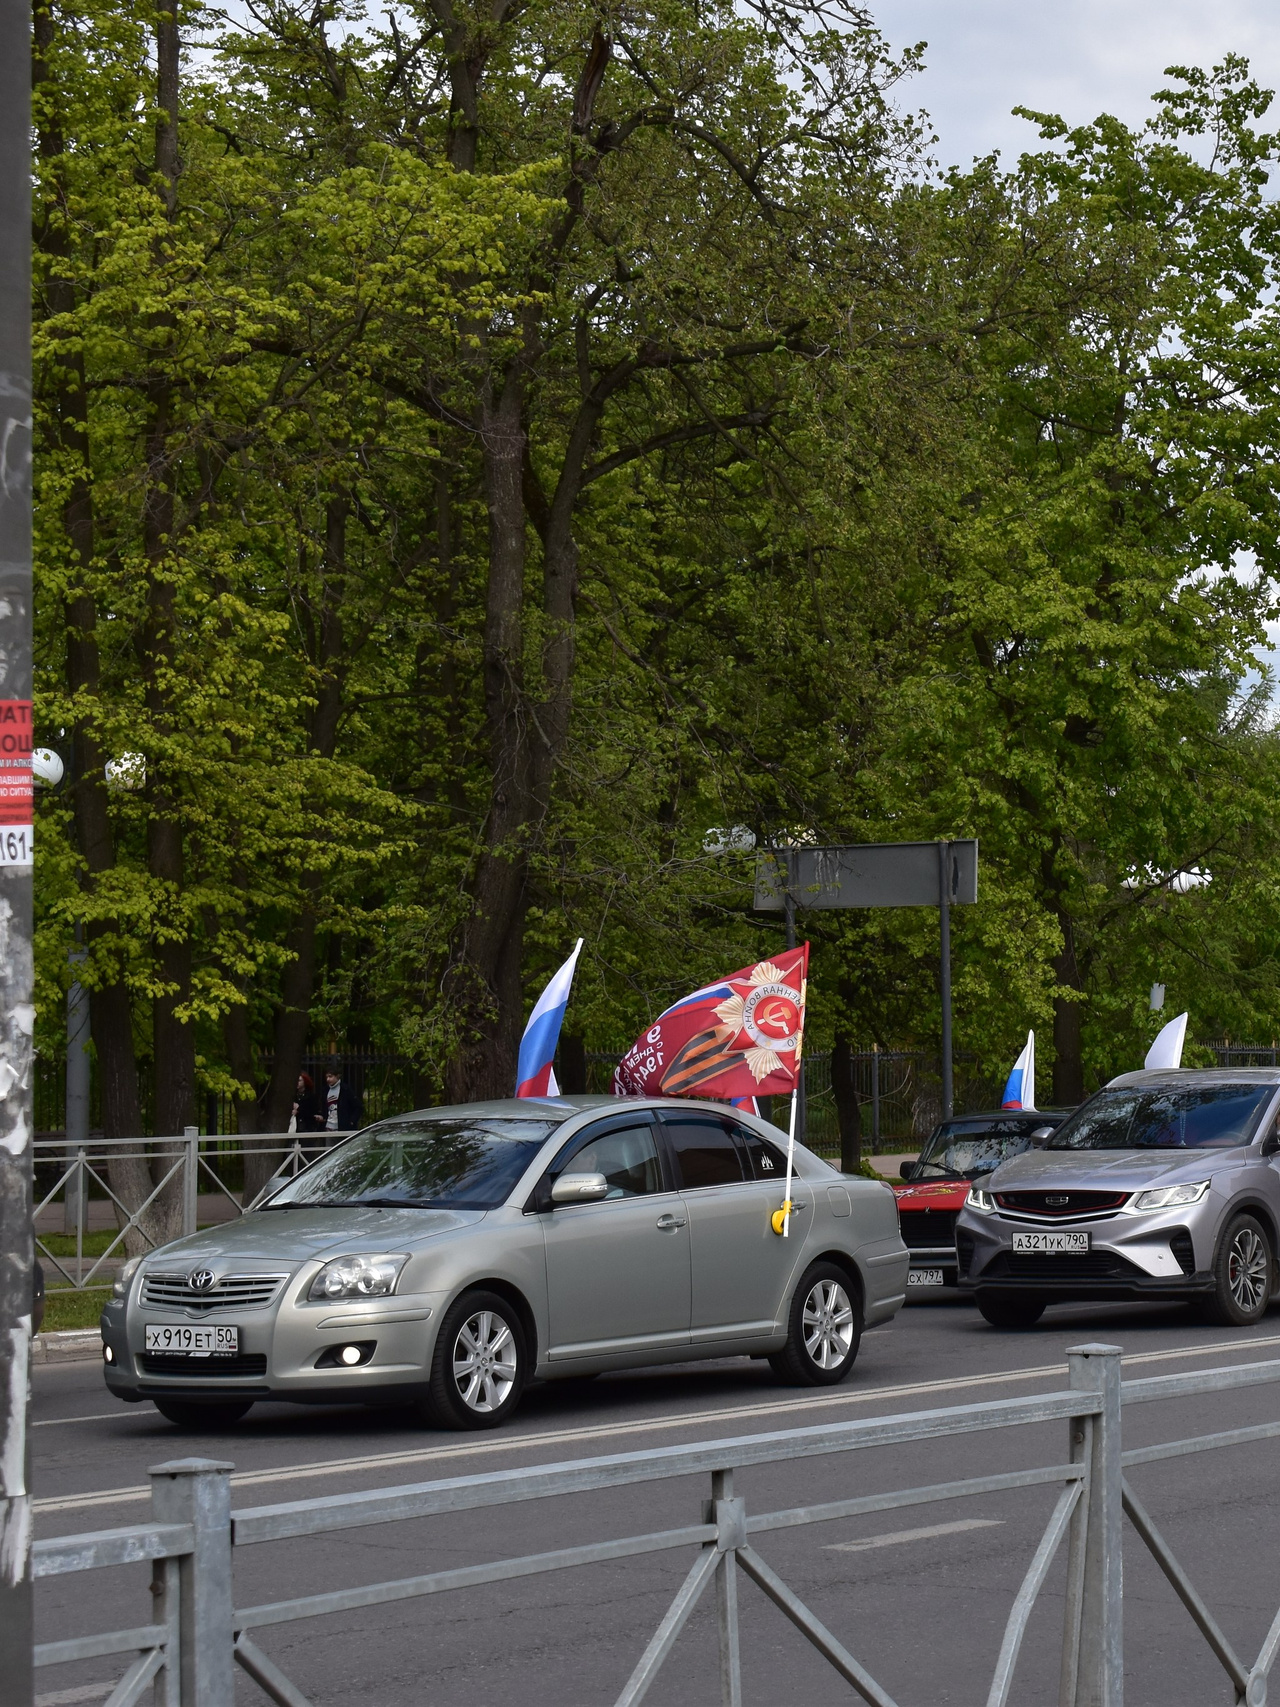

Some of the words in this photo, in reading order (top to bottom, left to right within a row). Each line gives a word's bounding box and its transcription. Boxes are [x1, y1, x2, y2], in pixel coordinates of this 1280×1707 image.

[1016, 1234, 1064, 1249] А321УК
[1066, 1234, 1085, 1245] 790
[924, 1270, 940, 1280] 797
[152, 1328, 212, 1348] Х919ЕТ
[217, 1328, 232, 1343] 50
